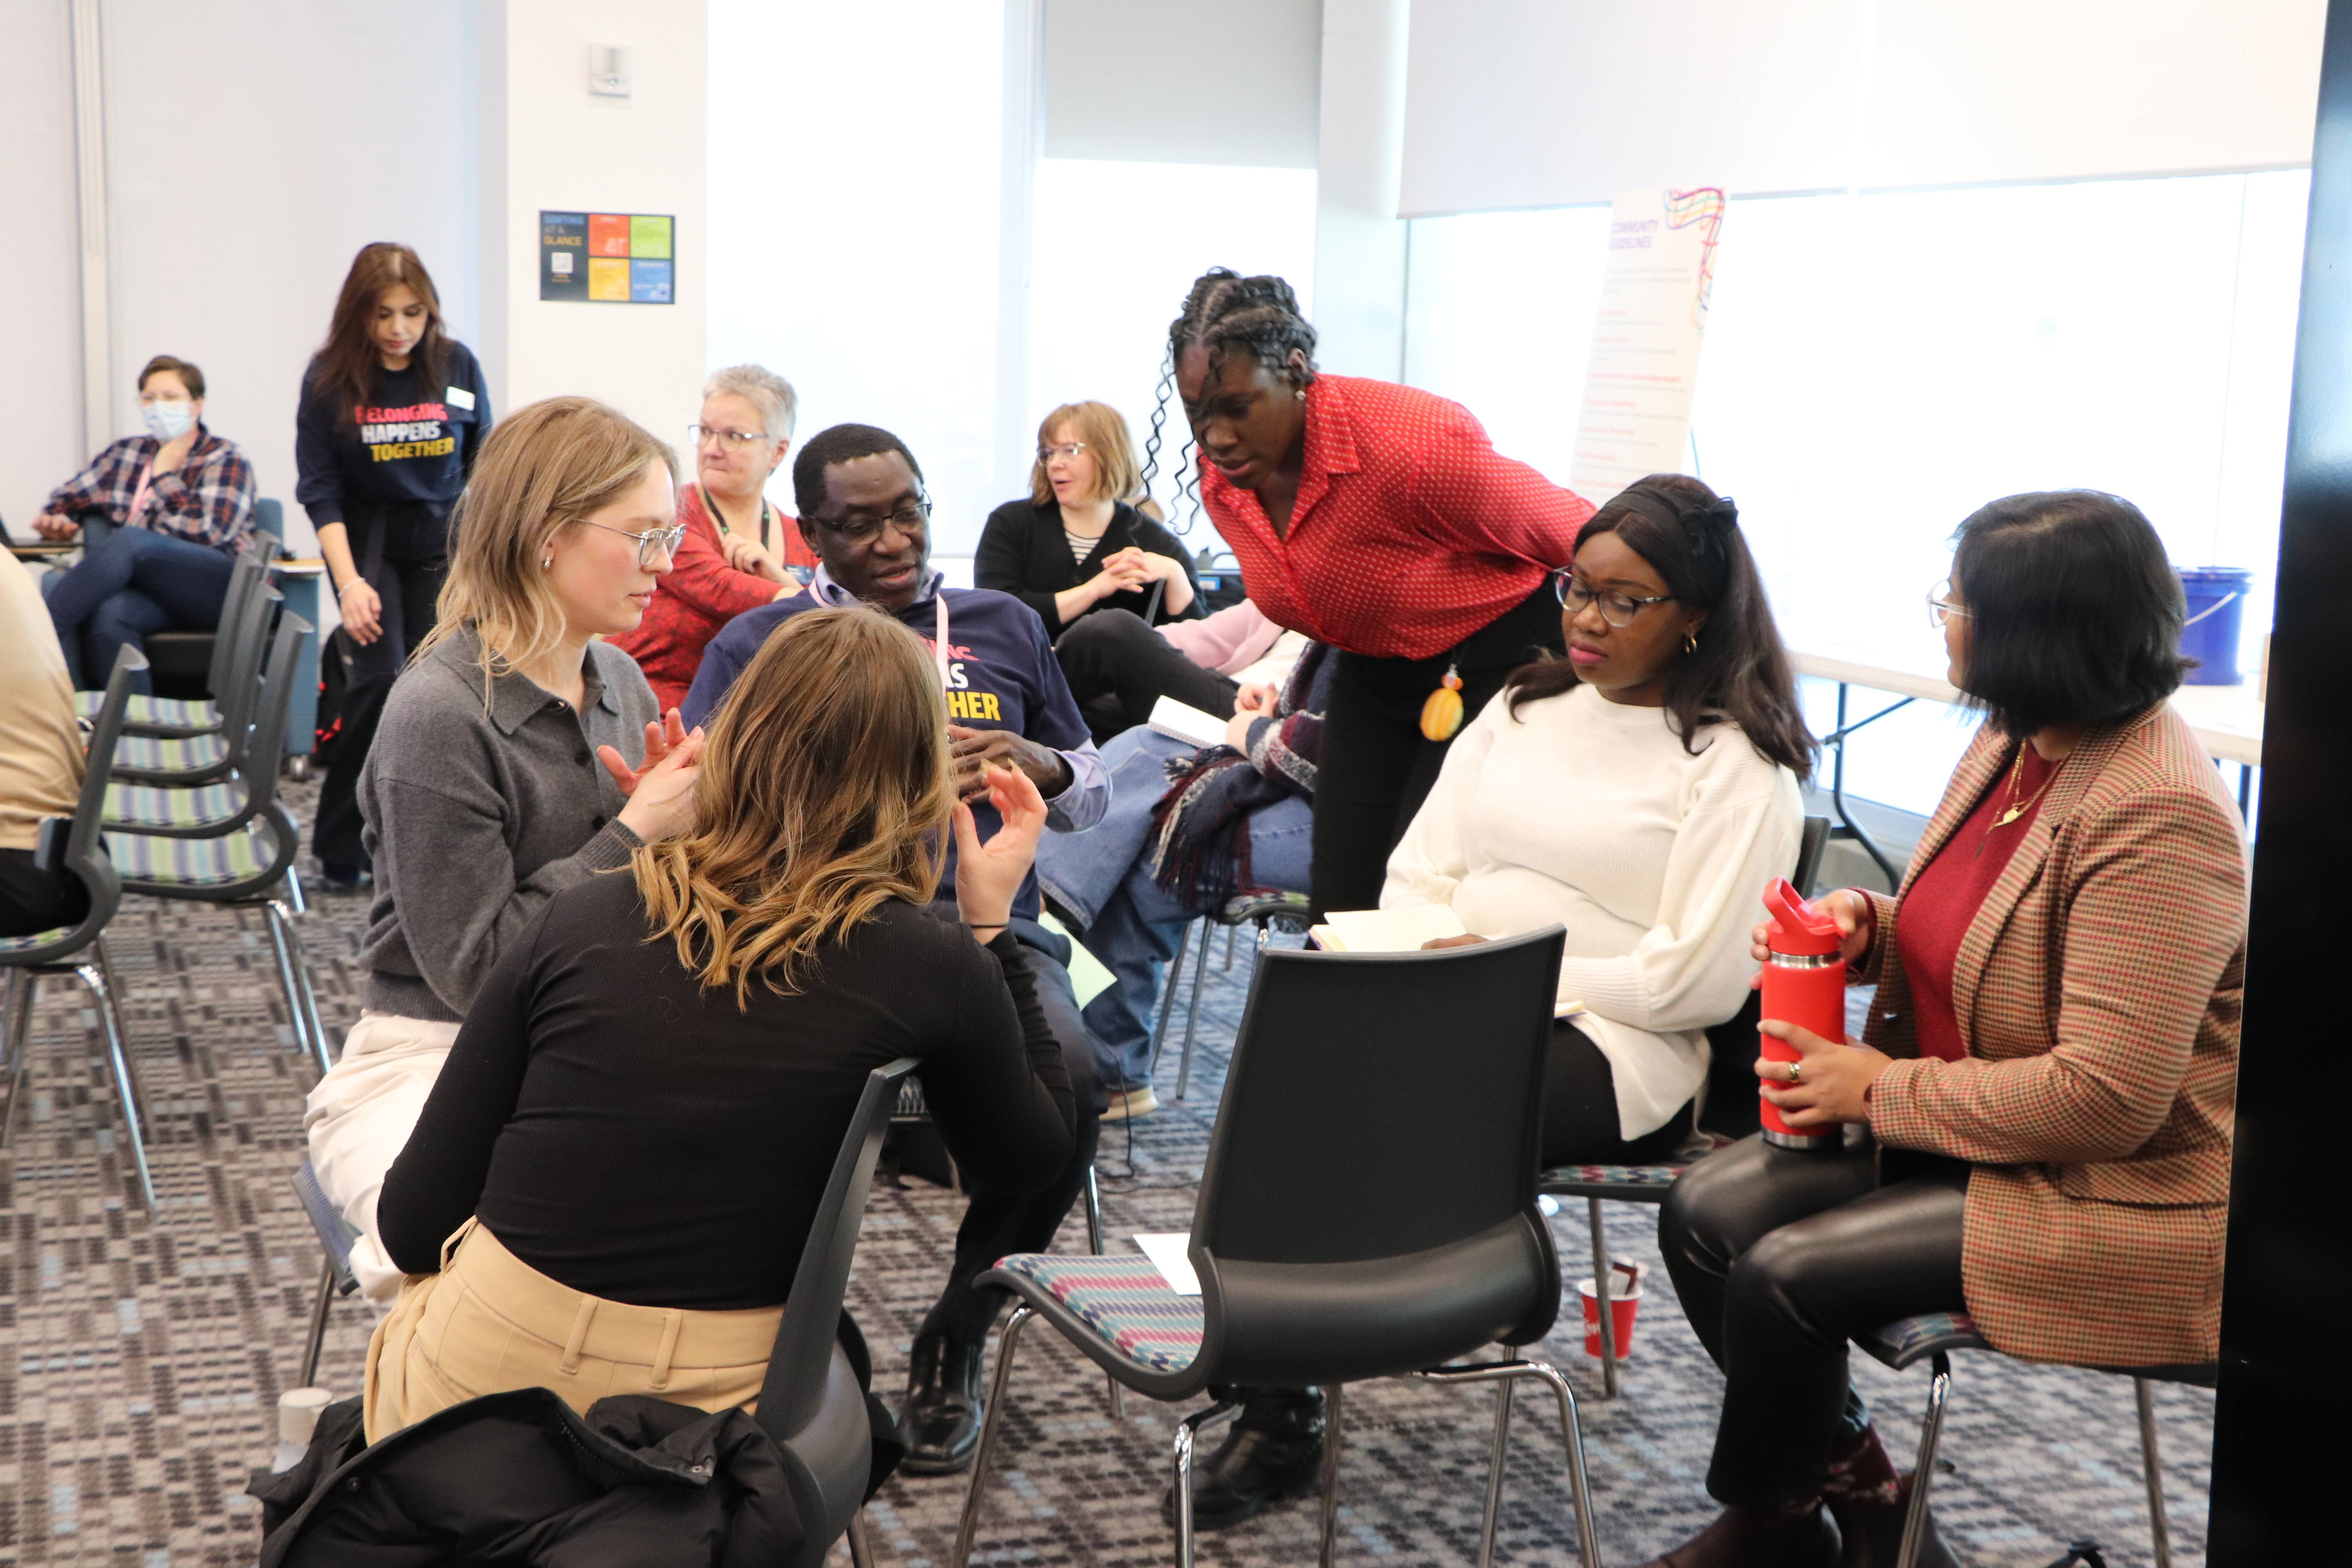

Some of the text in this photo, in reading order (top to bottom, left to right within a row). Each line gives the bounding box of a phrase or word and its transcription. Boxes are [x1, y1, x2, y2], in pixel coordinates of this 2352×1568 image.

[1612, 219, 1660, 234] COMMUNITY
[544, 235, 582, 246] GLANCE
[1610, 235, 1653, 250] GUIDELINES
[361, 420, 441, 444] HAPPENS
[370, 437, 455, 462] TOGETHER
